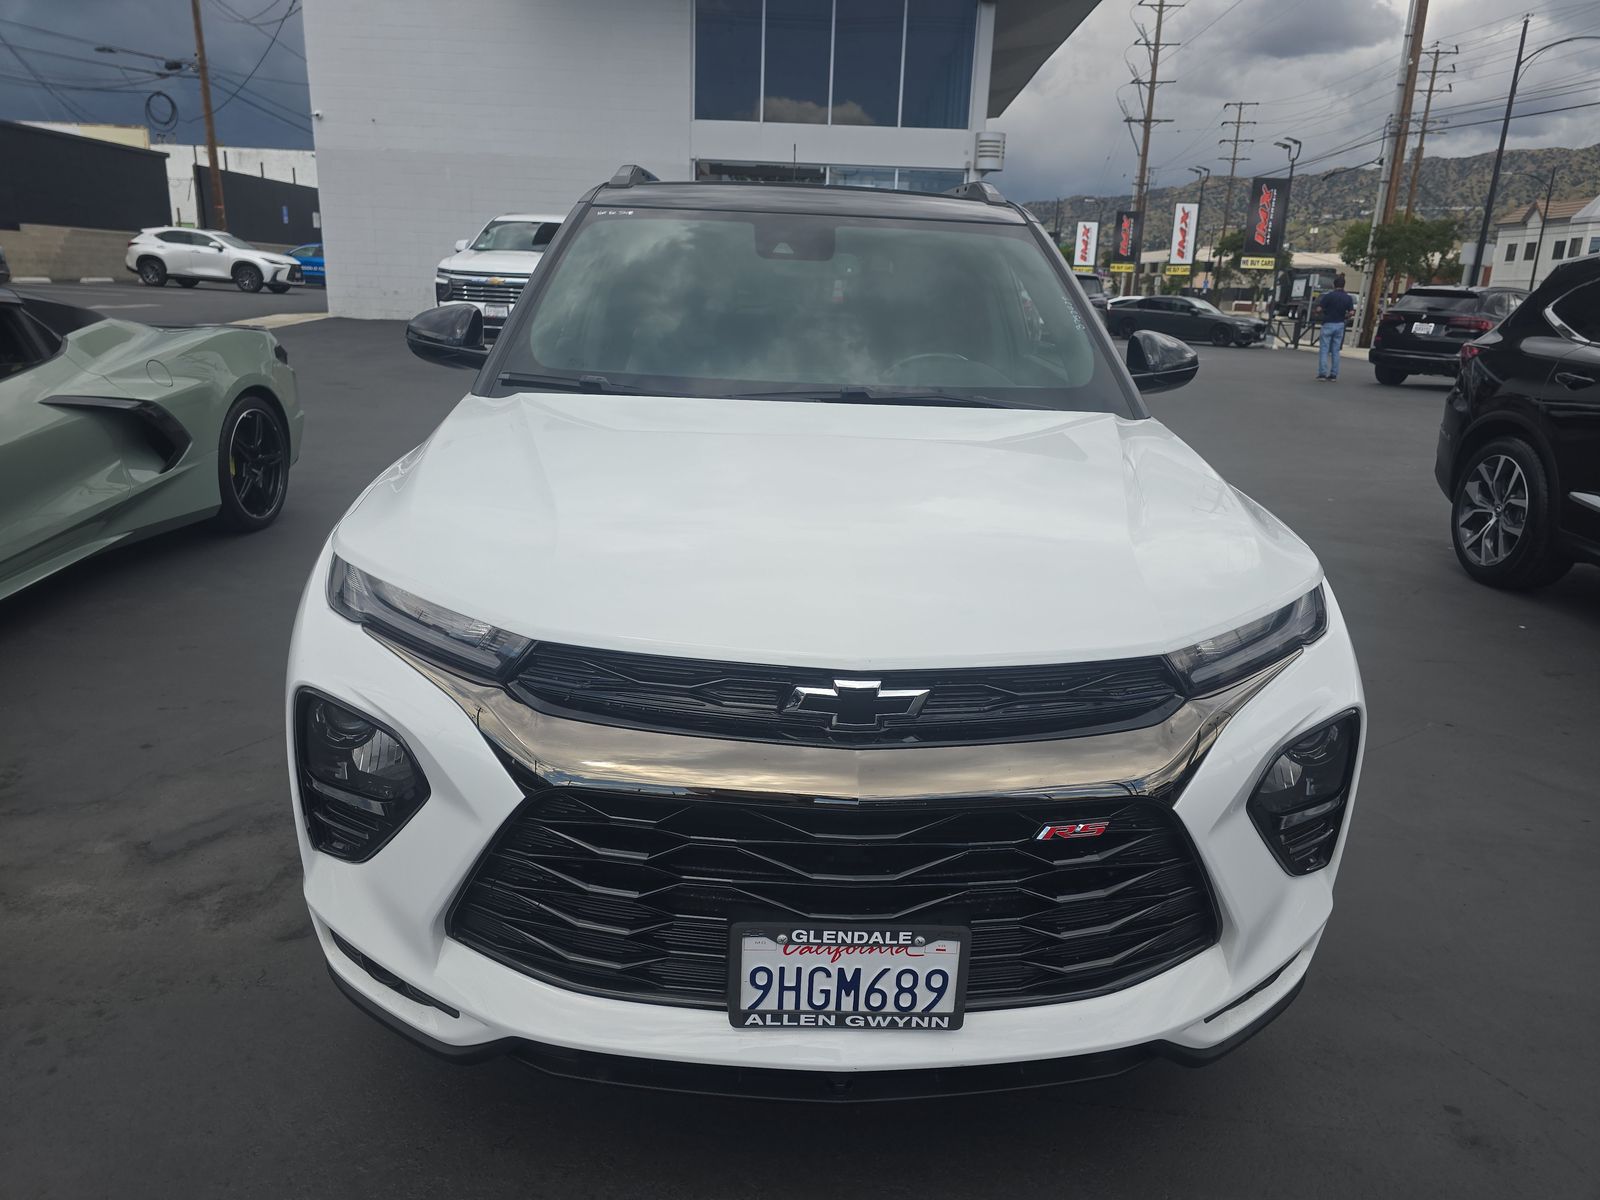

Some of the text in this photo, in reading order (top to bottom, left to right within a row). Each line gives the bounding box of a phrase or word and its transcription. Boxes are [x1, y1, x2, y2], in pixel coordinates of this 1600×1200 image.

[1254, 184, 1273, 246] IMX
[1079, 223, 1091, 262] IMX
[1119, 213, 1131, 257] IMX
[1176, 206, 1190, 259] IMX
[1260, 259, 1274, 267] CARS
[1036, 821, 1109, 840] RS
[791, 929, 912, 944] GLENDALE
[783, 943, 925, 963] California
[747, 966, 949, 1013] 9HGM689
[744, 1014, 949, 1028] ALLEN GWYNN
